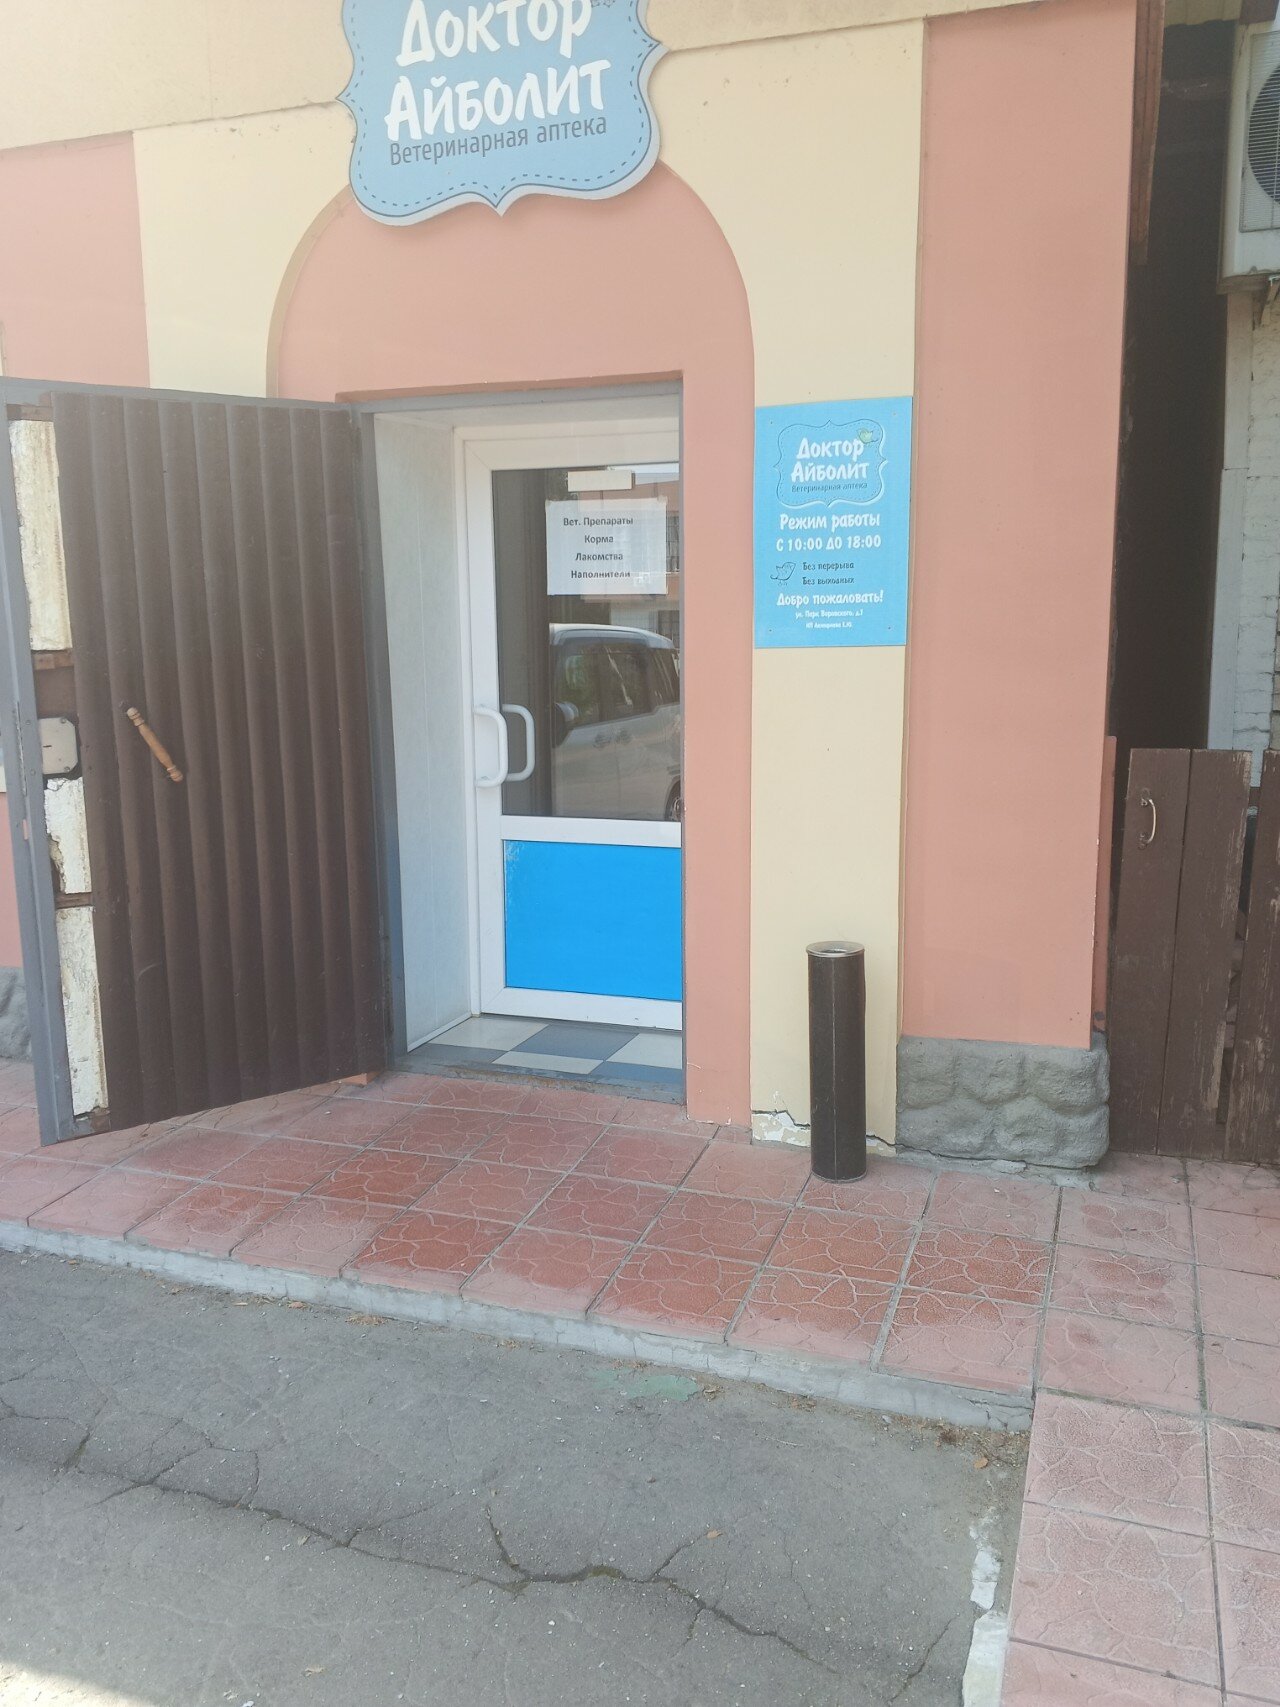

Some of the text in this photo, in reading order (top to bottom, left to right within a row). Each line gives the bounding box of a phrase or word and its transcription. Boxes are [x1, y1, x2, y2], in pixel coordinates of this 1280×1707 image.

[390, 117, 607, 166] Ветеринарная аптека
[791, 481, 868, 493] Ветеринарная аптека
[563, 517, 634, 527] Вет. Препараты
[780, 513, 880, 533] Режим работы
[584, 535, 614, 545] Корма
[788, 538, 823, 551] 10:00
[847, 535, 882, 549] 18:00
[575, 552, 624, 561] Лакомства
[802, 561, 855, 571] Без перерыва
[571, 570, 631, 579] Наполнители
[802, 576, 855, 586] Без выходных
[777, 589, 884, 608] Добро пожаловать!
